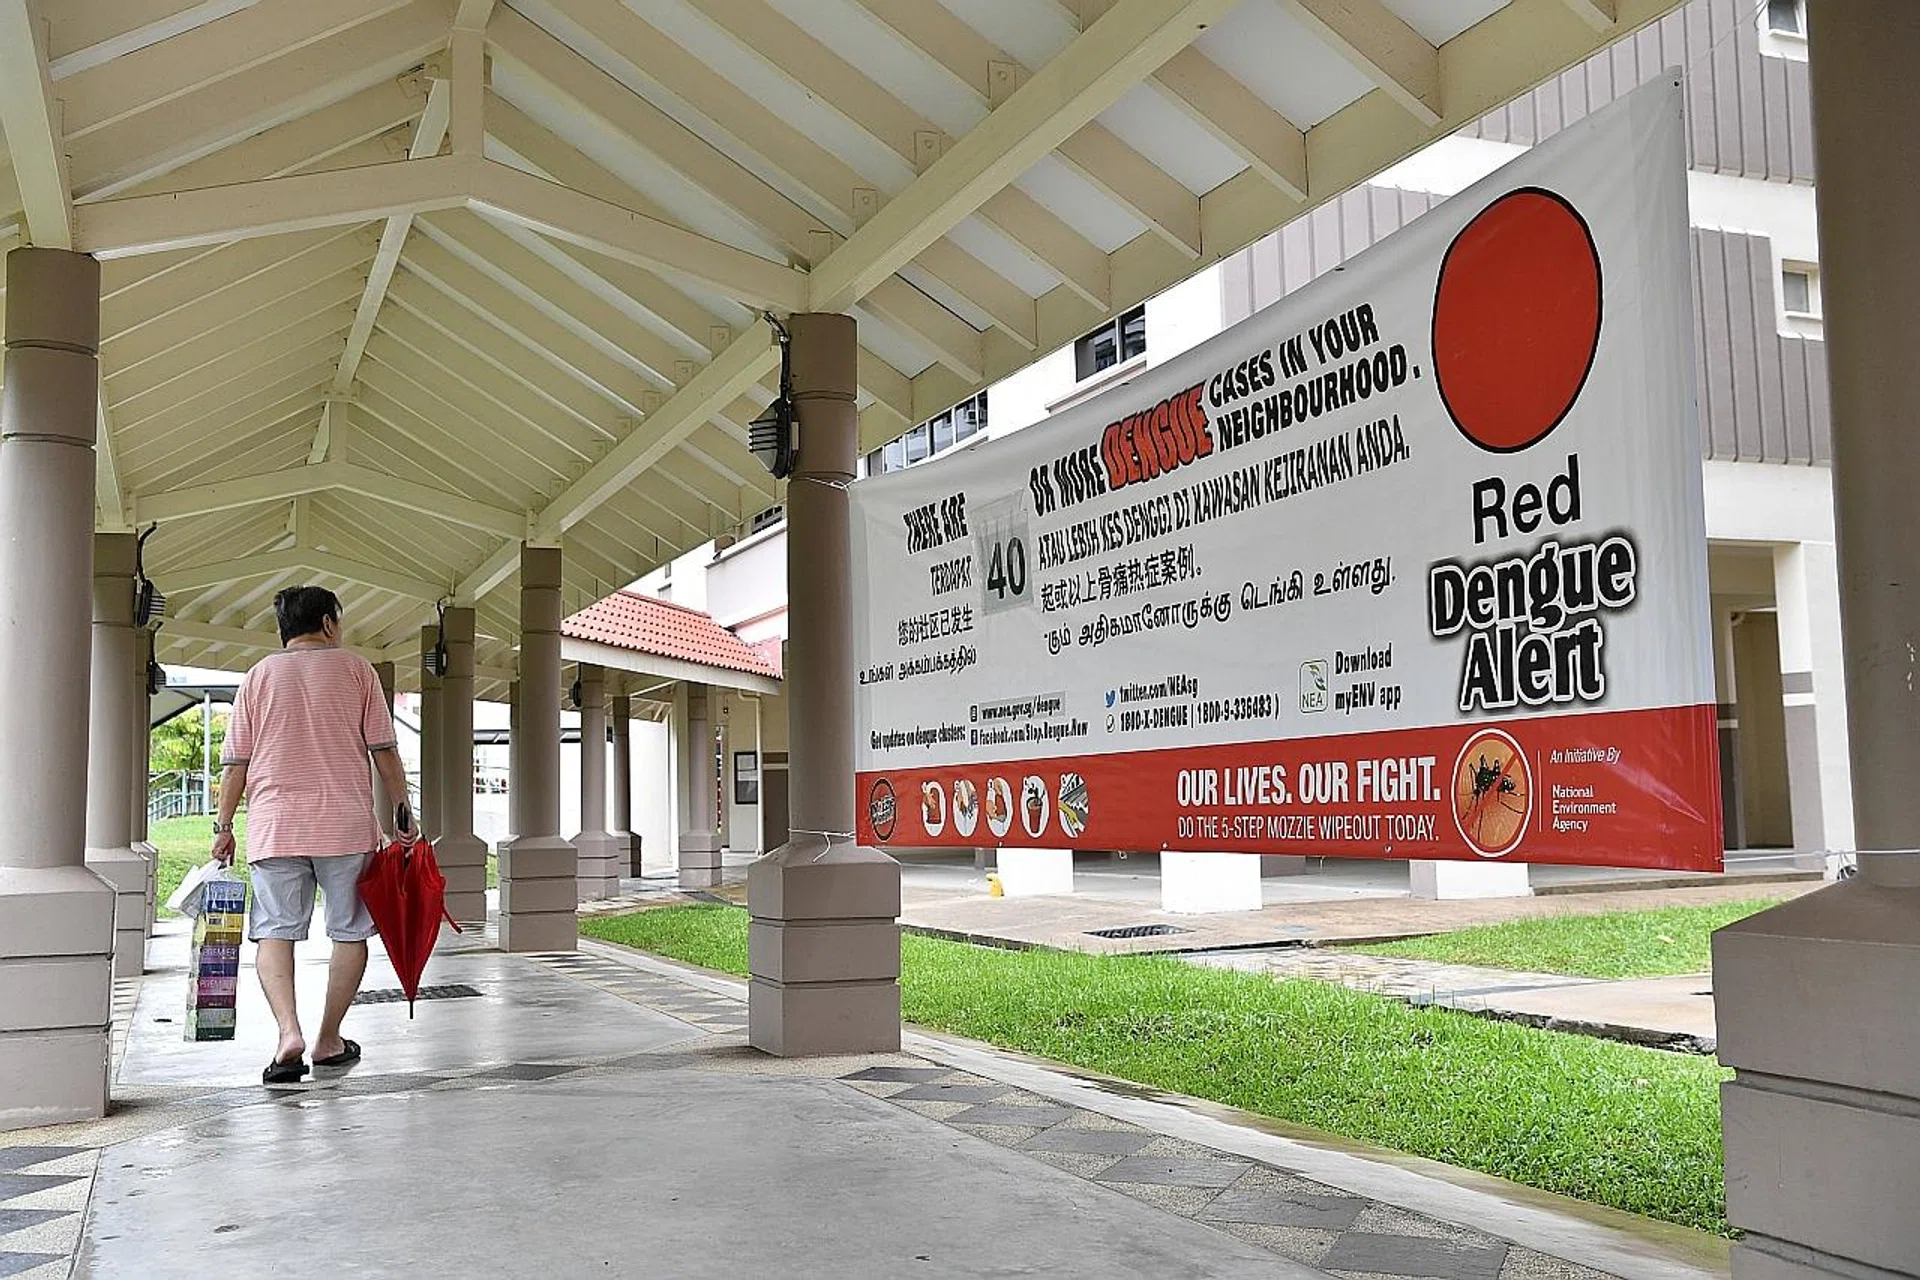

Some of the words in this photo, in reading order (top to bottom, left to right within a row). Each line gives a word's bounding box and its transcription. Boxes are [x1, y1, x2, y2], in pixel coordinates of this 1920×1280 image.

[1209, 350, 1275, 408] CASES
[1279, 333, 1307, 378] IN
[1308, 303, 1379, 365] YOUR
[1029, 467, 1056, 516] OR
[1054, 445, 1106, 507] MORE
[1101, 380, 1215, 490] DENGUE
[1038, 529, 1066, 571] ATAU
[1065, 519, 1100, 563] LEBIH
[1099, 510, 1124, 552] KES
[1123, 494, 1173, 545] DENGGI
[1172, 488, 1191, 531] DI
[1191, 464, 1261, 525] KAWASAN
[1264, 432, 1353, 504] KEJIRANAN
[1355, 414, 1411, 475] ANDA.
[1472, 453, 1581, 544] Red
[903, 503, 943, 554] THERE
[941, 492, 968, 542] ARE
[930, 556, 972, 596] TERDAPAT
[987, 537, 1026, 599] 40
[1040, 543, 1202, 613] 起或以上骨痛热症案例。
[1240, 568, 1304, 611] டெங்கி
[1431, 538, 1636, 634] Dengue
[898, 603, 974, 646] 您的社区已发生
[859, 661, 894, 685] உங்கள்
[1335, 642, 1392, 675] Download
[1460, 618, 1605, 711] Alert
[1302, 692, 1323, 708] NEA
[1335, 681, 1375, 715] myENV
[1380, 685, 1401, 711] app
[871, 730, 882, 750] Get
[882, 728, 906, 753] updates
[906, 731, 914, 747] on
[915, 725, 937, 750] dengue
[1550, 749, 1562, 764] An
[1564, 748, 1605, 764] Initiative
[1606, 747, 1621, 765] By
[1177, 769, 1218, 807] OUR
[1224, 764, 1293, 806] LIVES.
[1299, 761, 1349, 804] OUR
[1356, 756, 1441, 803] FIGHT.
[1552, 784, 1594, 799] National
[1178, 816, 1194, 839] DO
[1196, 815, 1218, 839] THE
[1222, 815, 1264, 839] 5-STEP
[1267, 815, 1316, 840] MOZZIE
[1318, 814, 1382, 841] WIPEOUT
[1385, 814, 1440, 842] TODAY.
[1552, 800, 1617, 815] Environment
[1552, 815, 1589, 833] Agency
